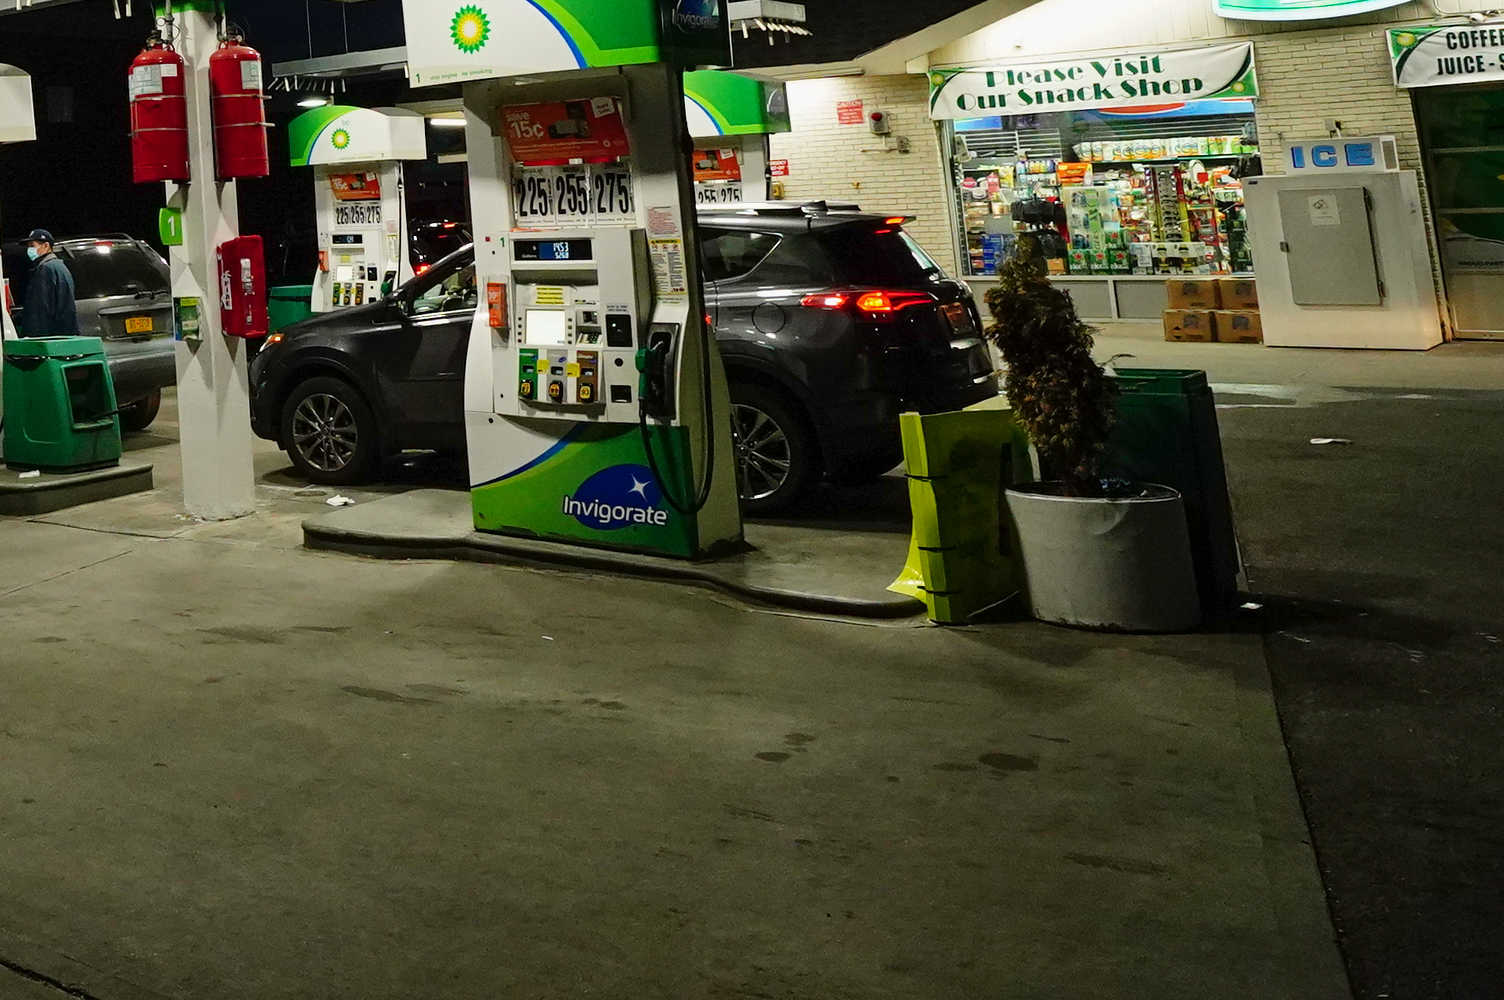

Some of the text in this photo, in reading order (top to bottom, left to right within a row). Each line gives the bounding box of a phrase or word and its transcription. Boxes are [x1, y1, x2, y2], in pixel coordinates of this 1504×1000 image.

[415, 73, 421, 83] 1
[985, 55, 1165, 87] Please Visit
[1437, 55, 1485, 75] JUICE
[957, 77, 1204, 112] Our Snack Shop
[1290, 142, 1376, 169] ICE
[517, 172, 629, 216] 225 255 275
[167, 216, 176, 236] 1
[499, 237, 505, 247] 1
[563, 496, 668, 525] Invigorate
